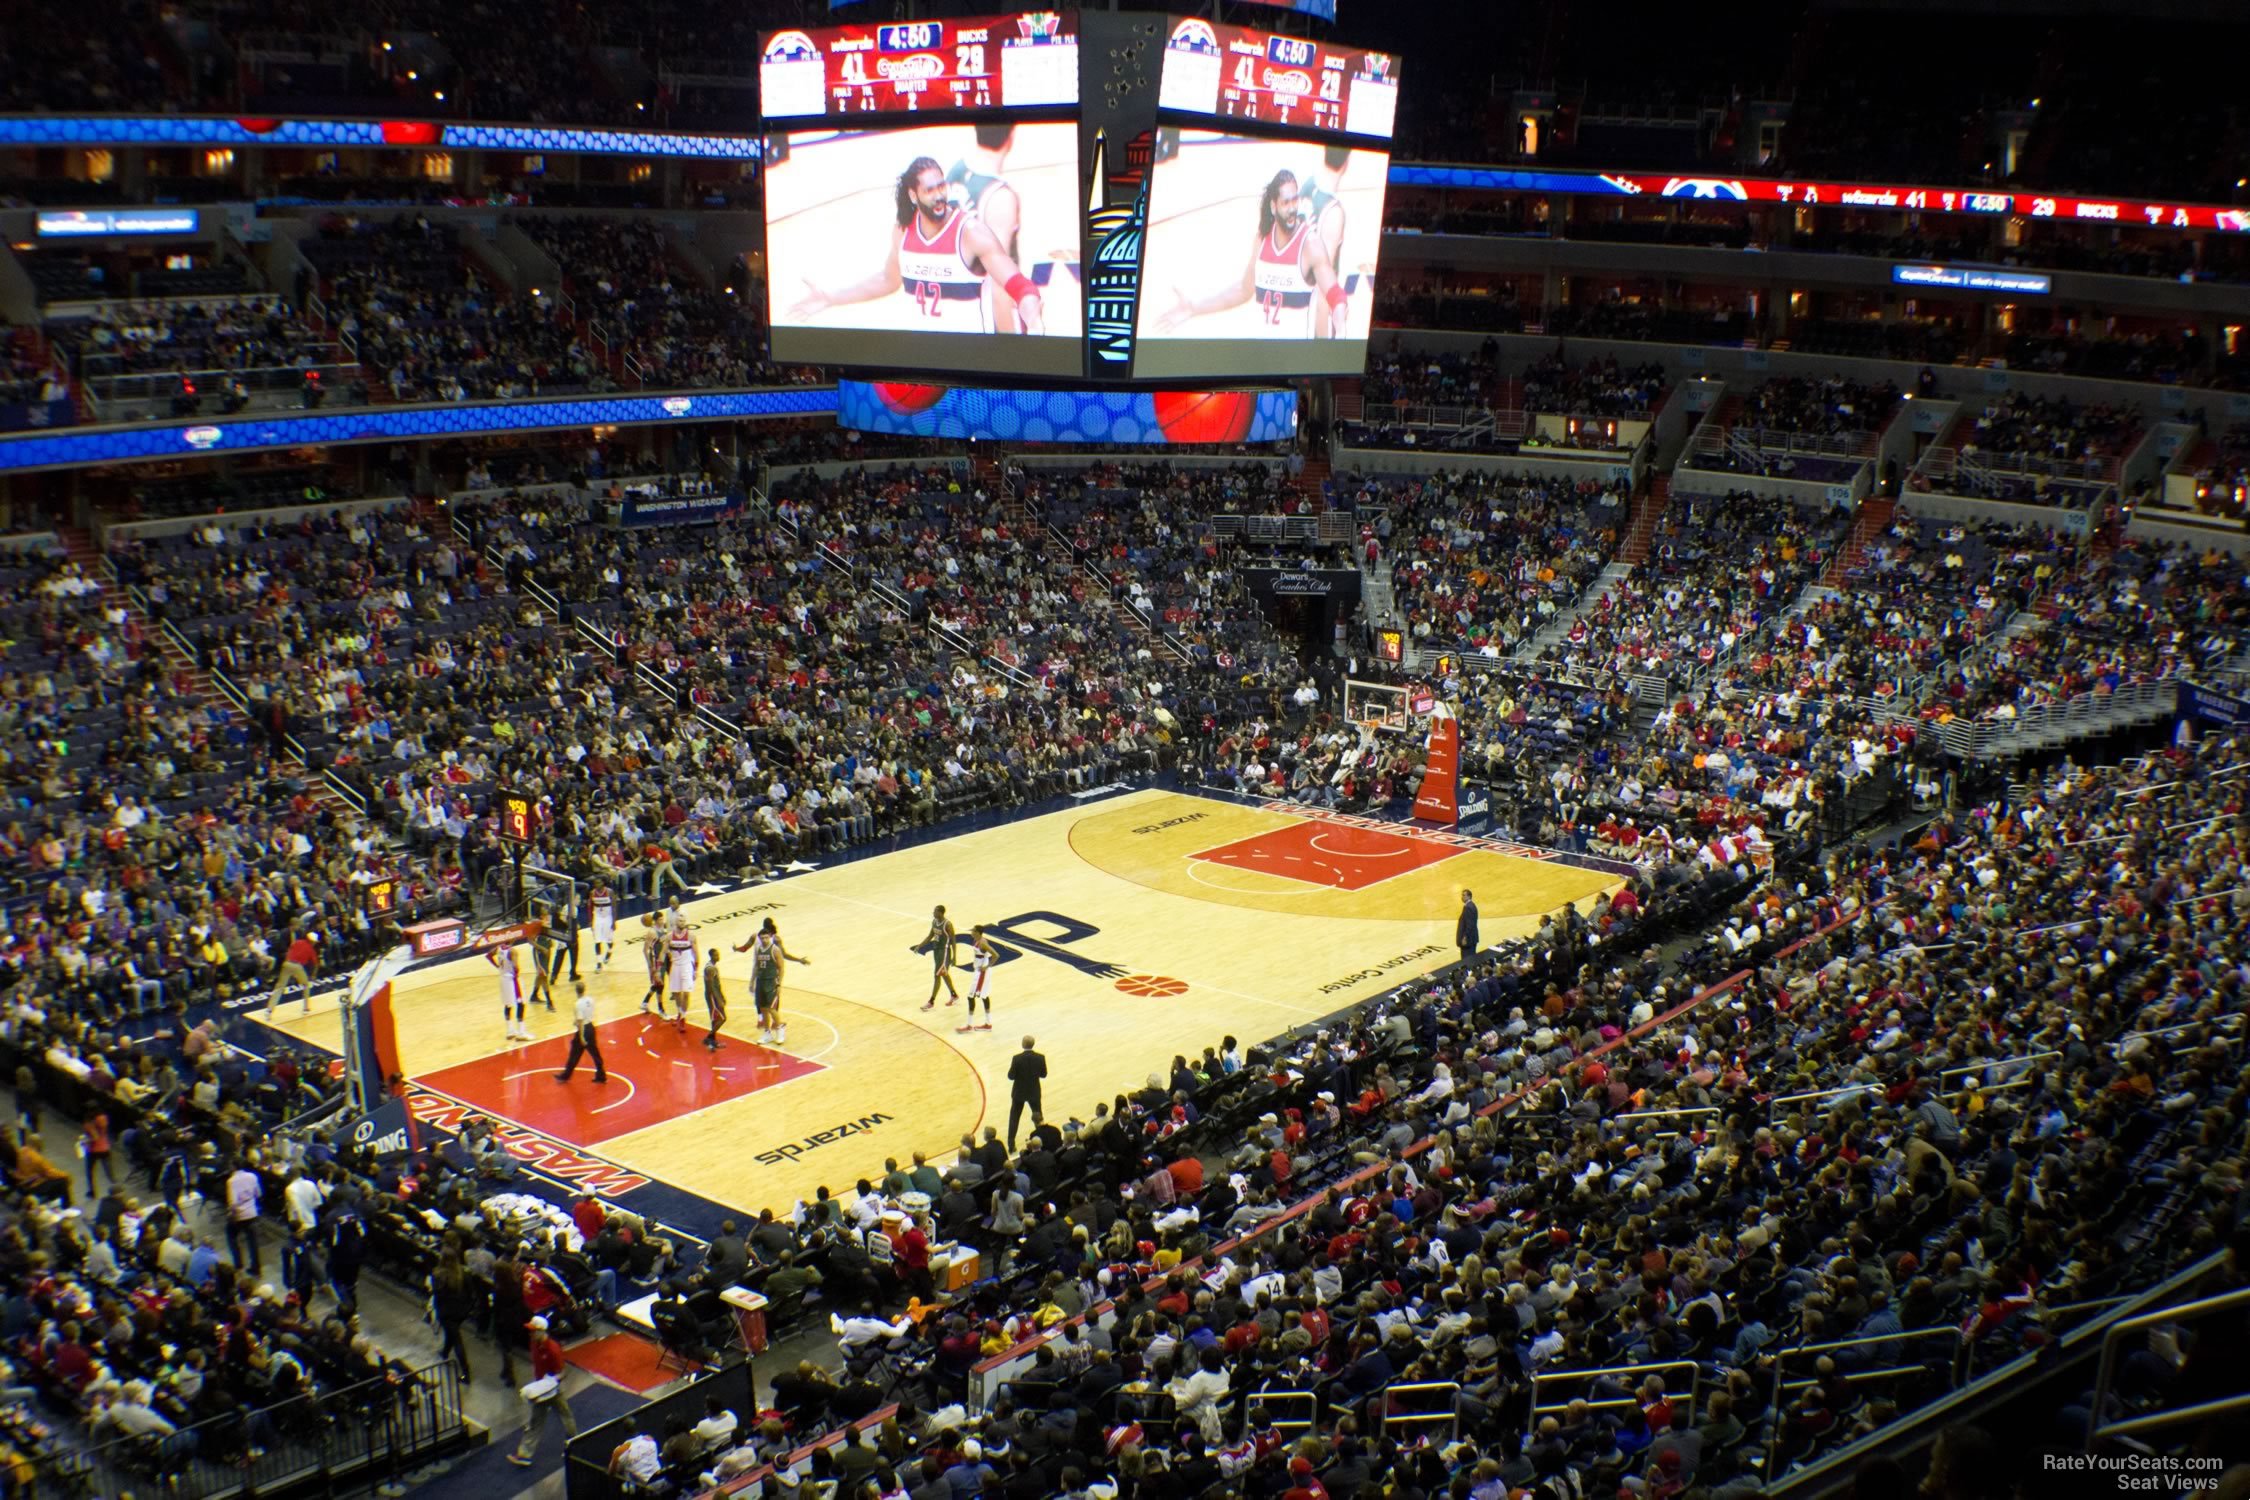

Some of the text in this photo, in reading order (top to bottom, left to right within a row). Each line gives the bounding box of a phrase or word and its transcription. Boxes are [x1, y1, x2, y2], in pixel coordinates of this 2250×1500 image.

[888, 25, 931, 48] 4:50
[957, 29, 988, 43] BUCKS
[956, 45, 985, 76] 29
[1276, 40, 1308, 65] 4:50
[841, 53, 867, 83] 41
[1234, 56, 1254, 88] 41
[894, 79, 928, 94] QUARTER
[1320, 70, 1341, 99] 29
[908, 92, 917, 110] 2
[1842, 189, 1898, 206] wizards
[1906, 191, 1926, 208] 41
[2032, 198, 2118, 219] 29 BUCKS
[915, 281, 942, 318] 42
[1263, 290, 1283, 325] 42
[951, 461, 966, 471] 109
[636, 496, 727, 513] WASHINGTON WIZARDS
[1270, 577, 1332, 591] Coaches Club
[1388, 643, 1397, 659] 9
[1458, 798, 1488, 819] SPALDING
[514, 815, 525, 838] 9
[1132, 812, 1210, 835] wizards
[1260, 802, 1562, 860] WASHINGTON
[377, 895, 386, 909] 9
[701, 902, 787, 925] Verizon
[1318, 944, 1448, 994] Verizon Center
[754, 1112, 894, 1165] wizards
[961, 1263, 970, 1275] G
[1266, 1280, 1282, 1297] 14
